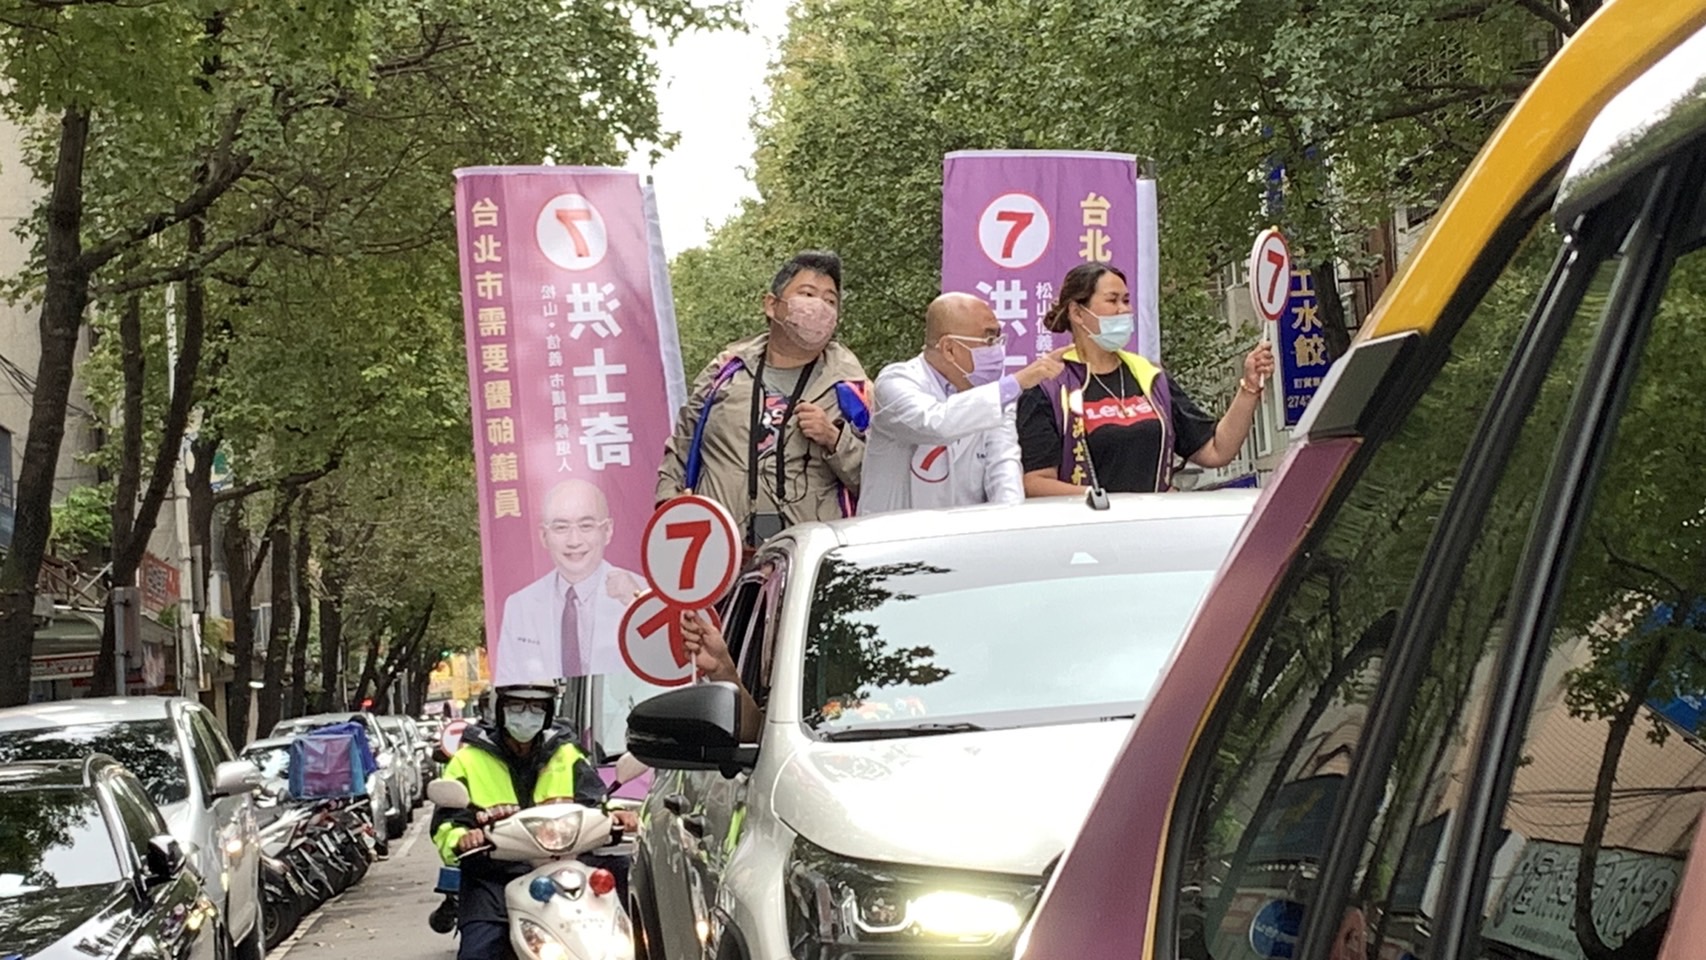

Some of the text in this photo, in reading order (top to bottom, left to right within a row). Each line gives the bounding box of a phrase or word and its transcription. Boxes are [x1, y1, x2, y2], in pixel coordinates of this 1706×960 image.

[996, 210, 1035, 259] 7
[1267, 249, 1284, 305] 7
[665, 520, 712, 591] 7
